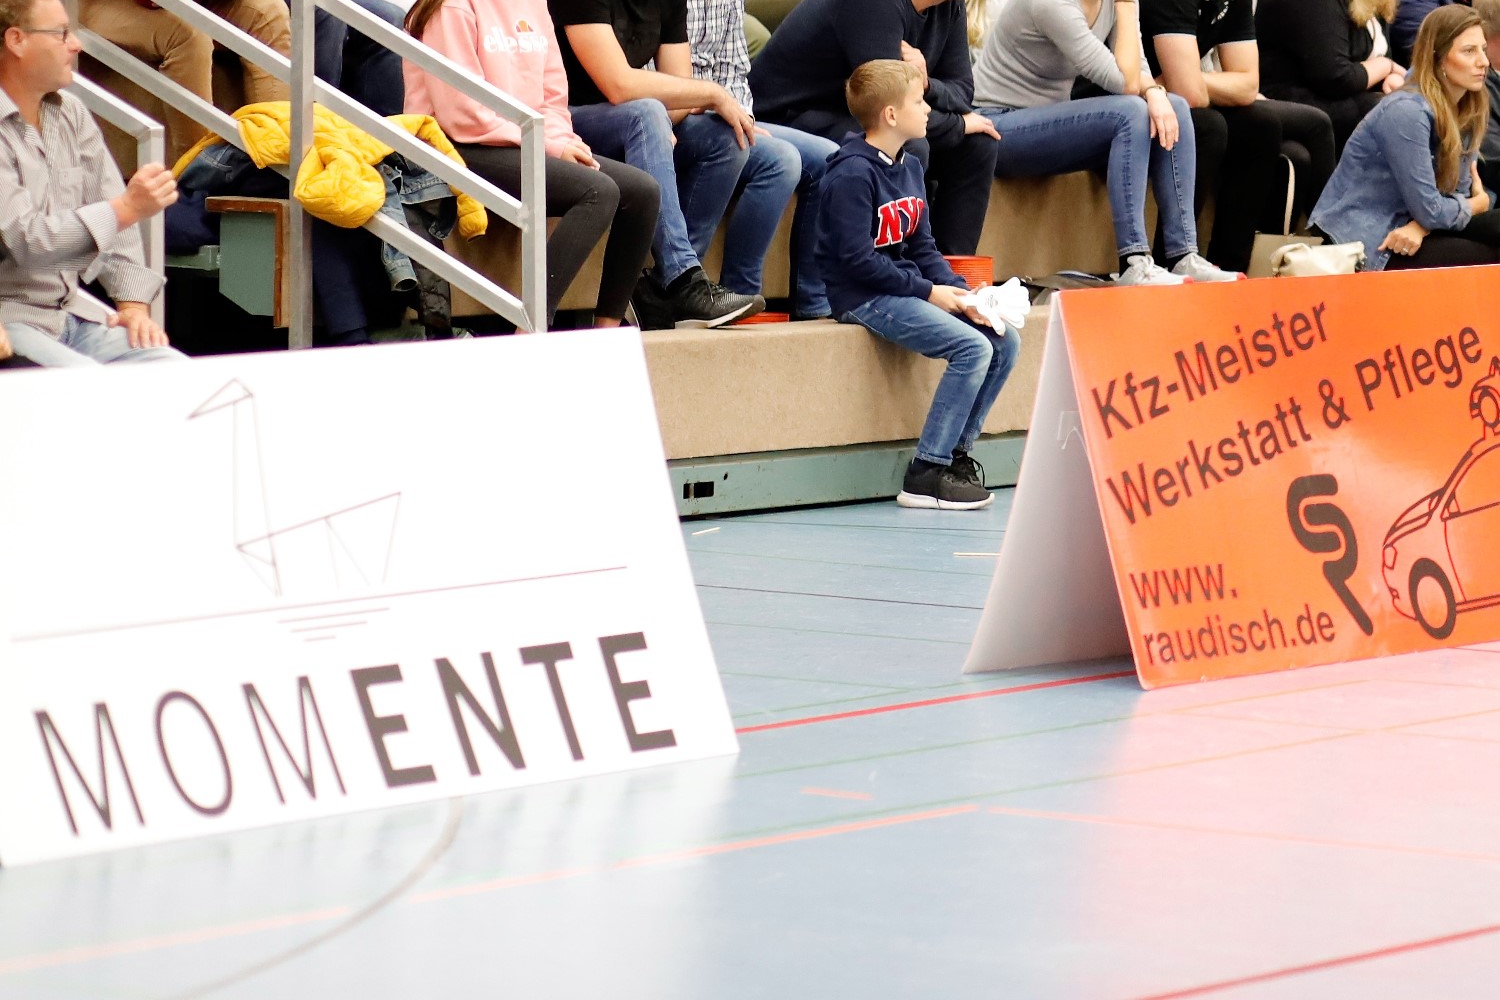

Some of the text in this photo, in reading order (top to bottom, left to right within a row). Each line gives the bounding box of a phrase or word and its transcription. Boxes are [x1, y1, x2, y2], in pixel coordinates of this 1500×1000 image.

[1092, 302, 1327, 439] Kfz-Meister
[1106, 326, 1483, 525] Werkstatt & Pflege
[1129, 563, 1238, 609] www.
[1143, 603, 1336, 666] raudisch.de
[33, 631, 677, 837] MOMENTE
